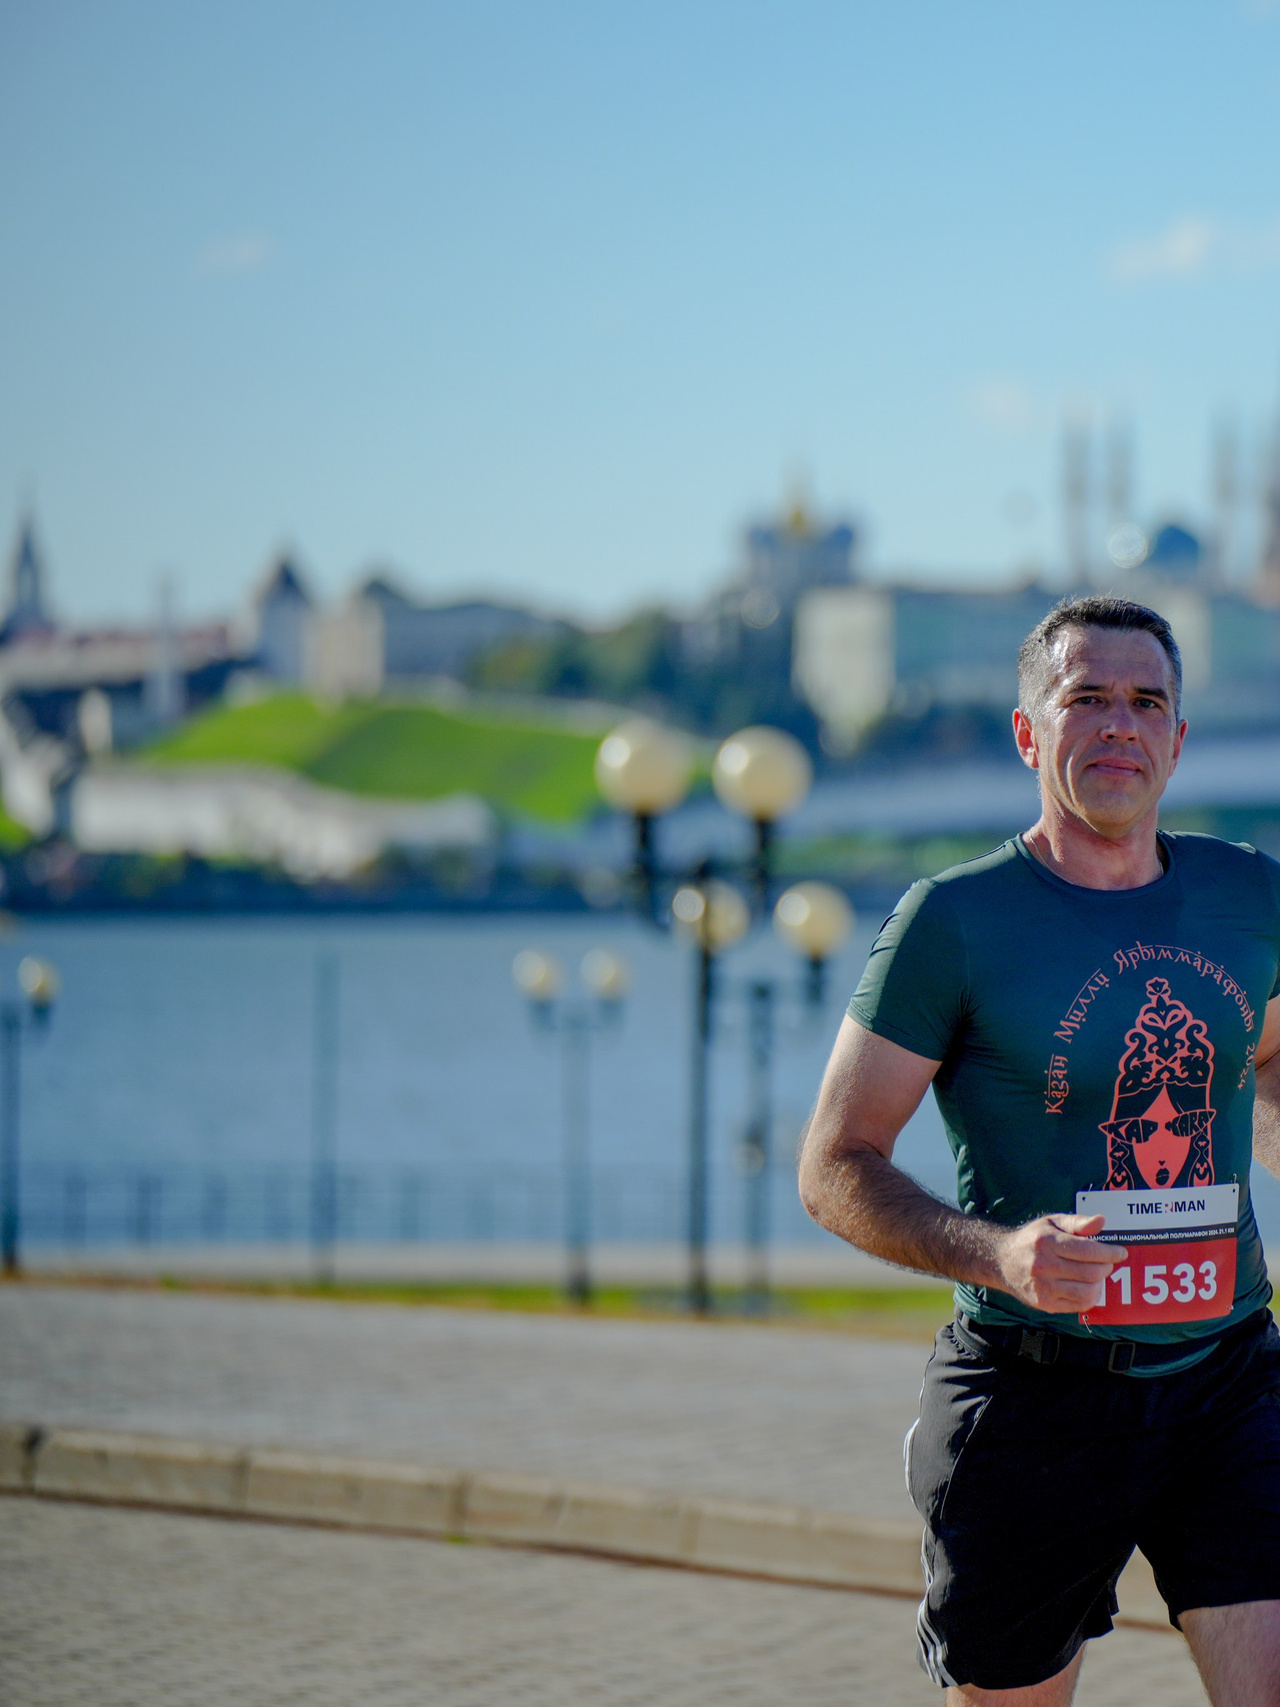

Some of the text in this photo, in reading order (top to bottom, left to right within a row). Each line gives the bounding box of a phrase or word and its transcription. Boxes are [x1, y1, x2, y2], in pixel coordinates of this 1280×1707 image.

[1086, 1233, 1118, 1242] ЗАНСКИЙ
[1119, 1232, 1170, 1242] НАЦИОНАЛЬНЫЙ
[1170, 1230, 1208, 1240] ПОЛУМАРАФОН
